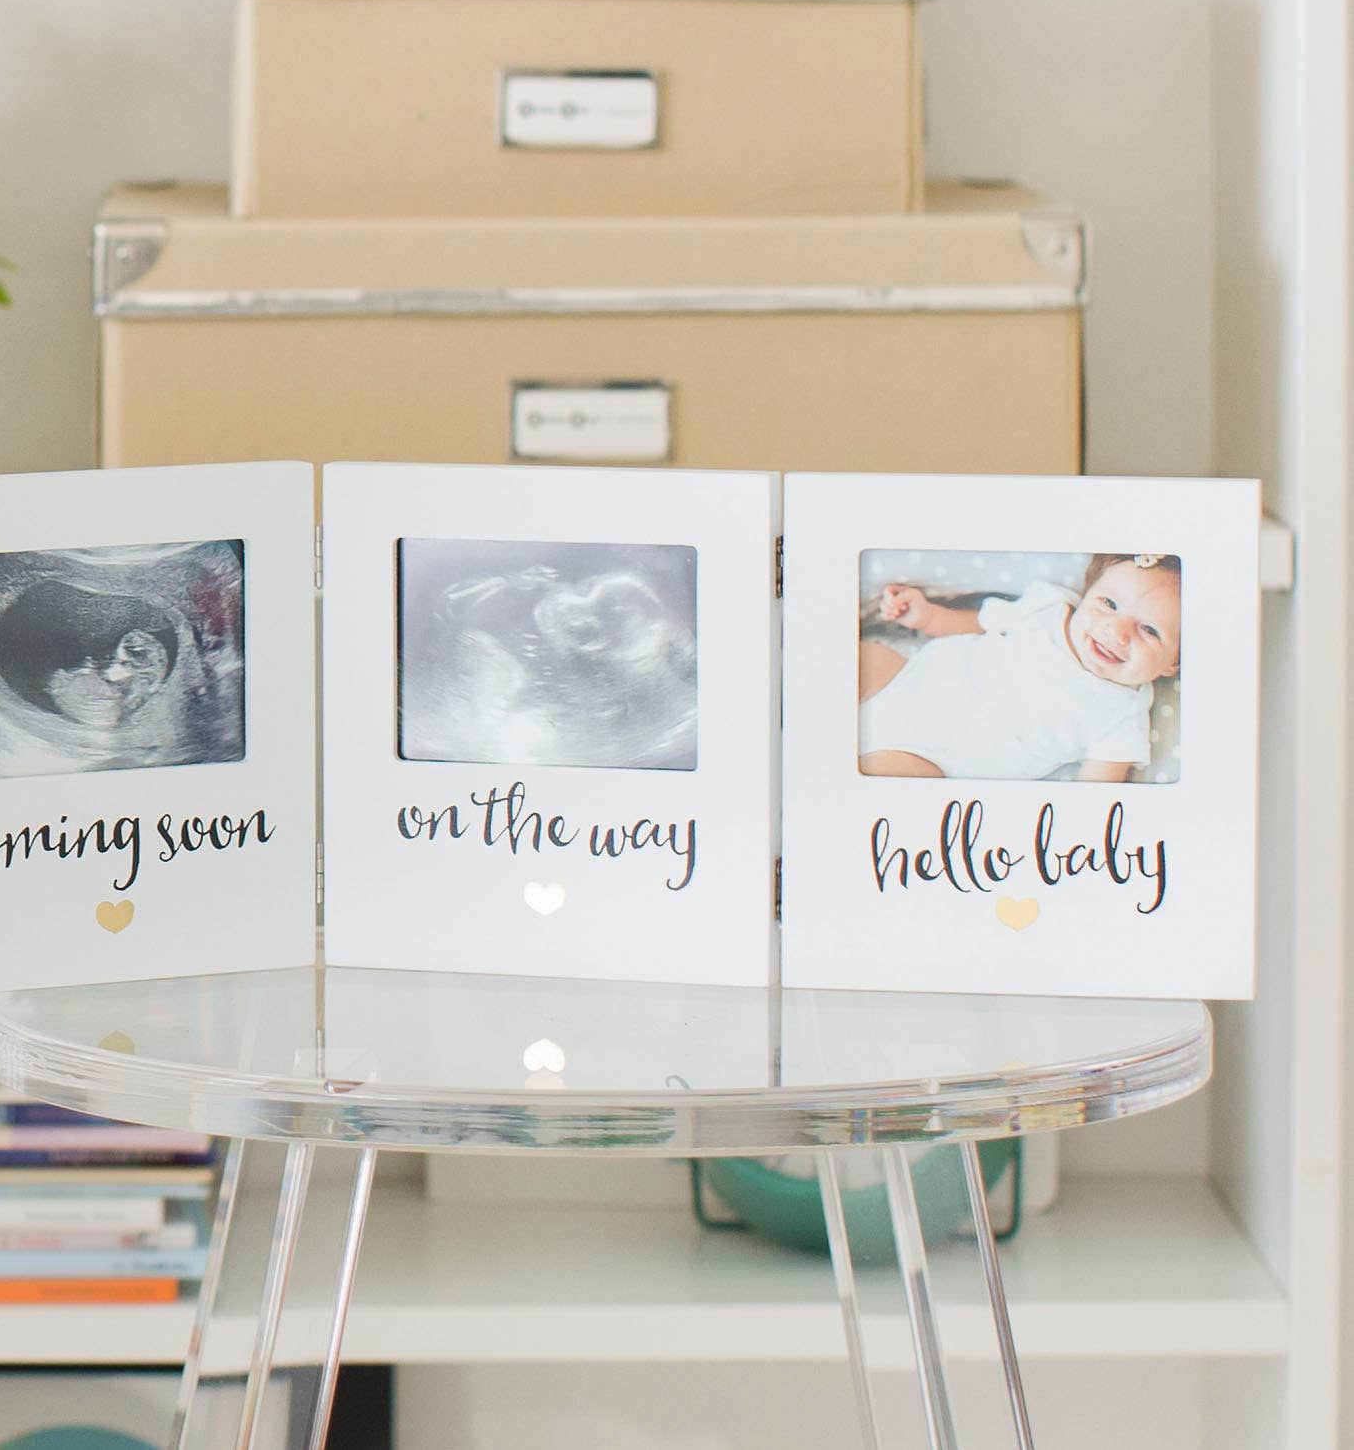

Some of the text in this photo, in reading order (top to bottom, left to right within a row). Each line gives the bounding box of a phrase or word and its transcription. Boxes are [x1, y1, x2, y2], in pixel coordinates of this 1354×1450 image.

[156, 808, 276, 864] soon
[396, 780, 698, 891] on the way
[870, 799, 1167, 916] hello baby
